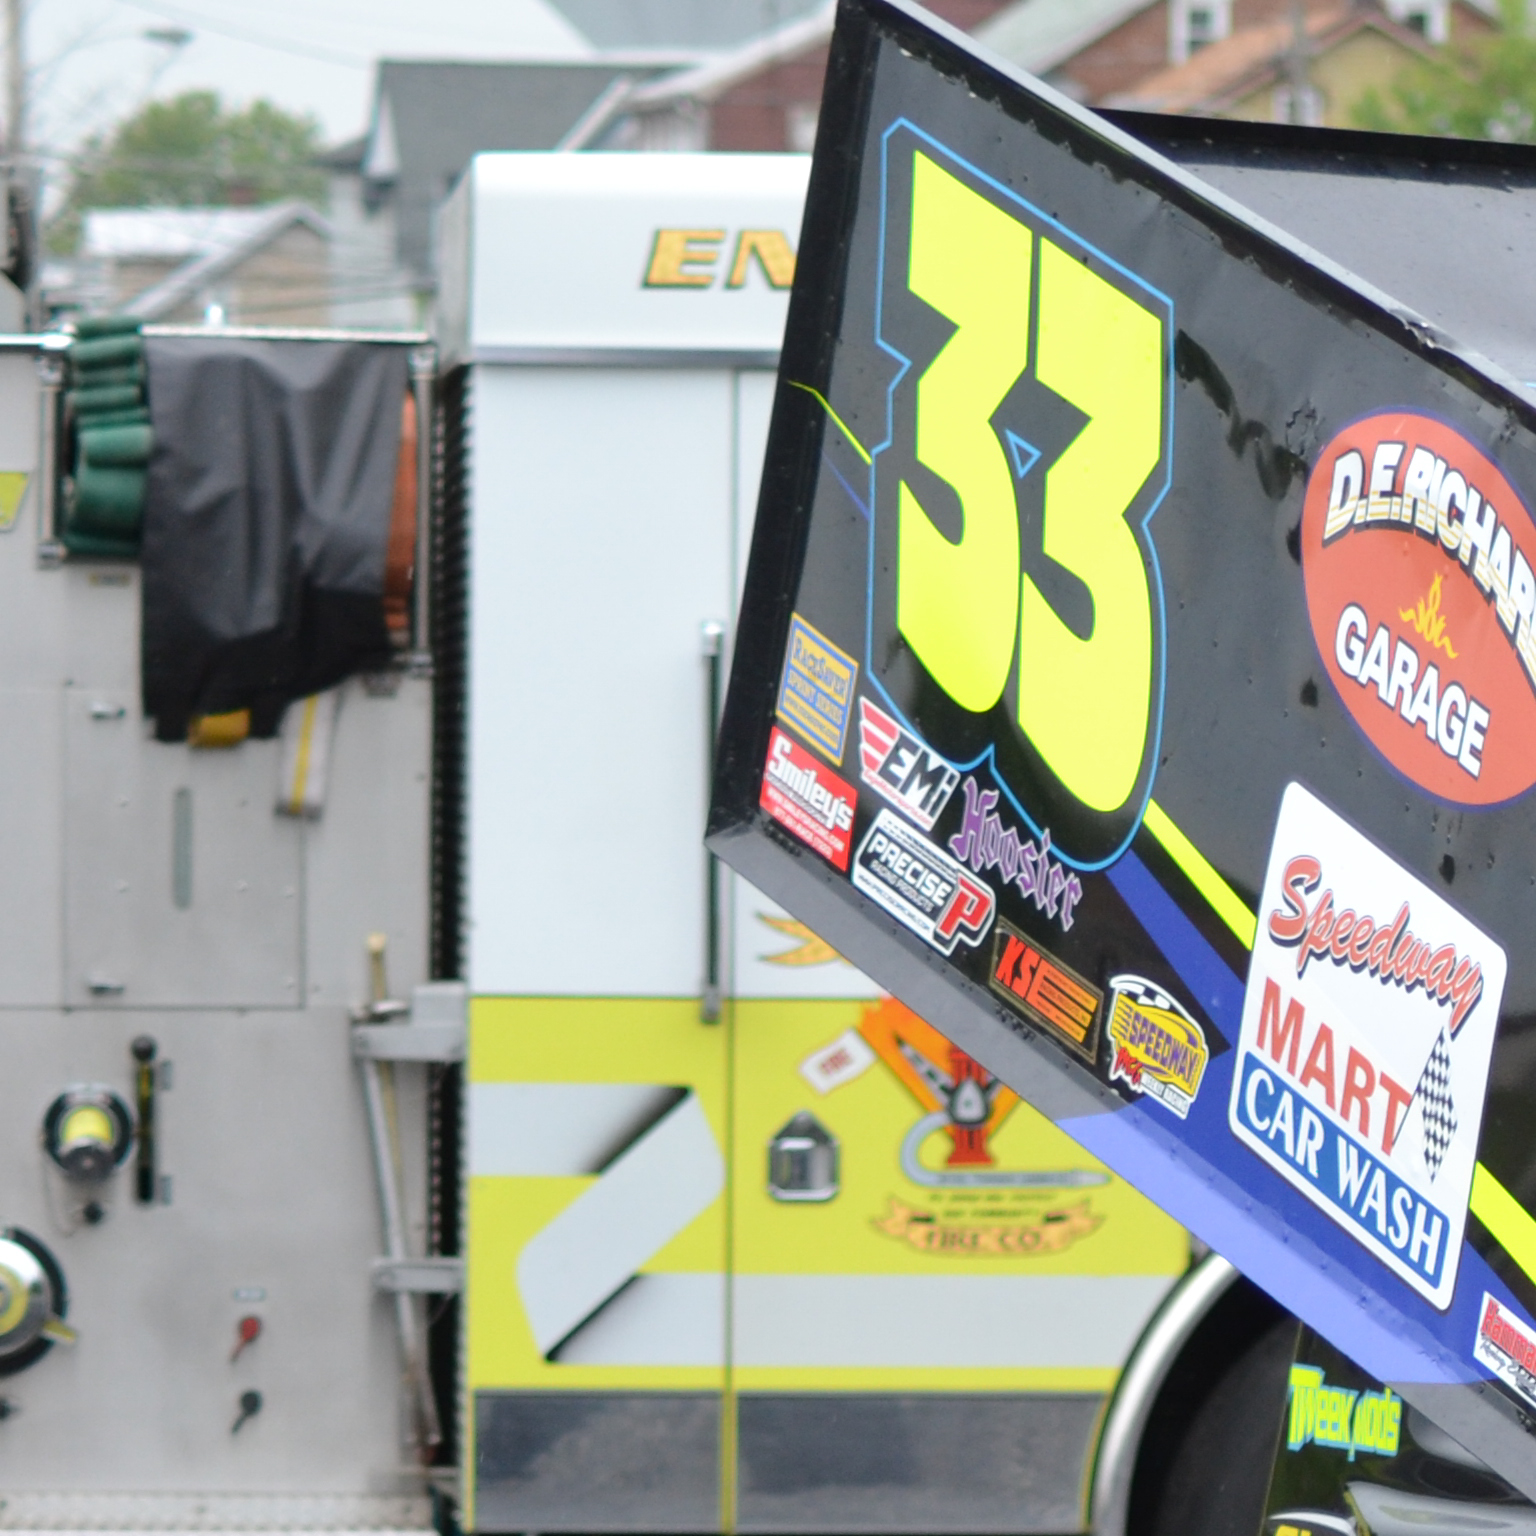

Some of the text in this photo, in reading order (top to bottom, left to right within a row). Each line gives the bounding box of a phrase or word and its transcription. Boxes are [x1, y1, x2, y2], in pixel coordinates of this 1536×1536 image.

[896, 149, 1162, 812] 33
[1334, 602, 1491, 778] GARAGE
[768, 734, 854, 832] Smiley's
[948, 775, 1083, 932] Hoosier
[867, 832, 953, 908] PRECISE
[1269, 855, 1484, 1042] Speedway
[995, 934, 1098, 1043] KSE
[1128, 1009, 1199, 1085] SPEEDWAY
[1256, 976, 1413, 1157] MART
[1244, 1066, 1444, 1276] CAR WASH
